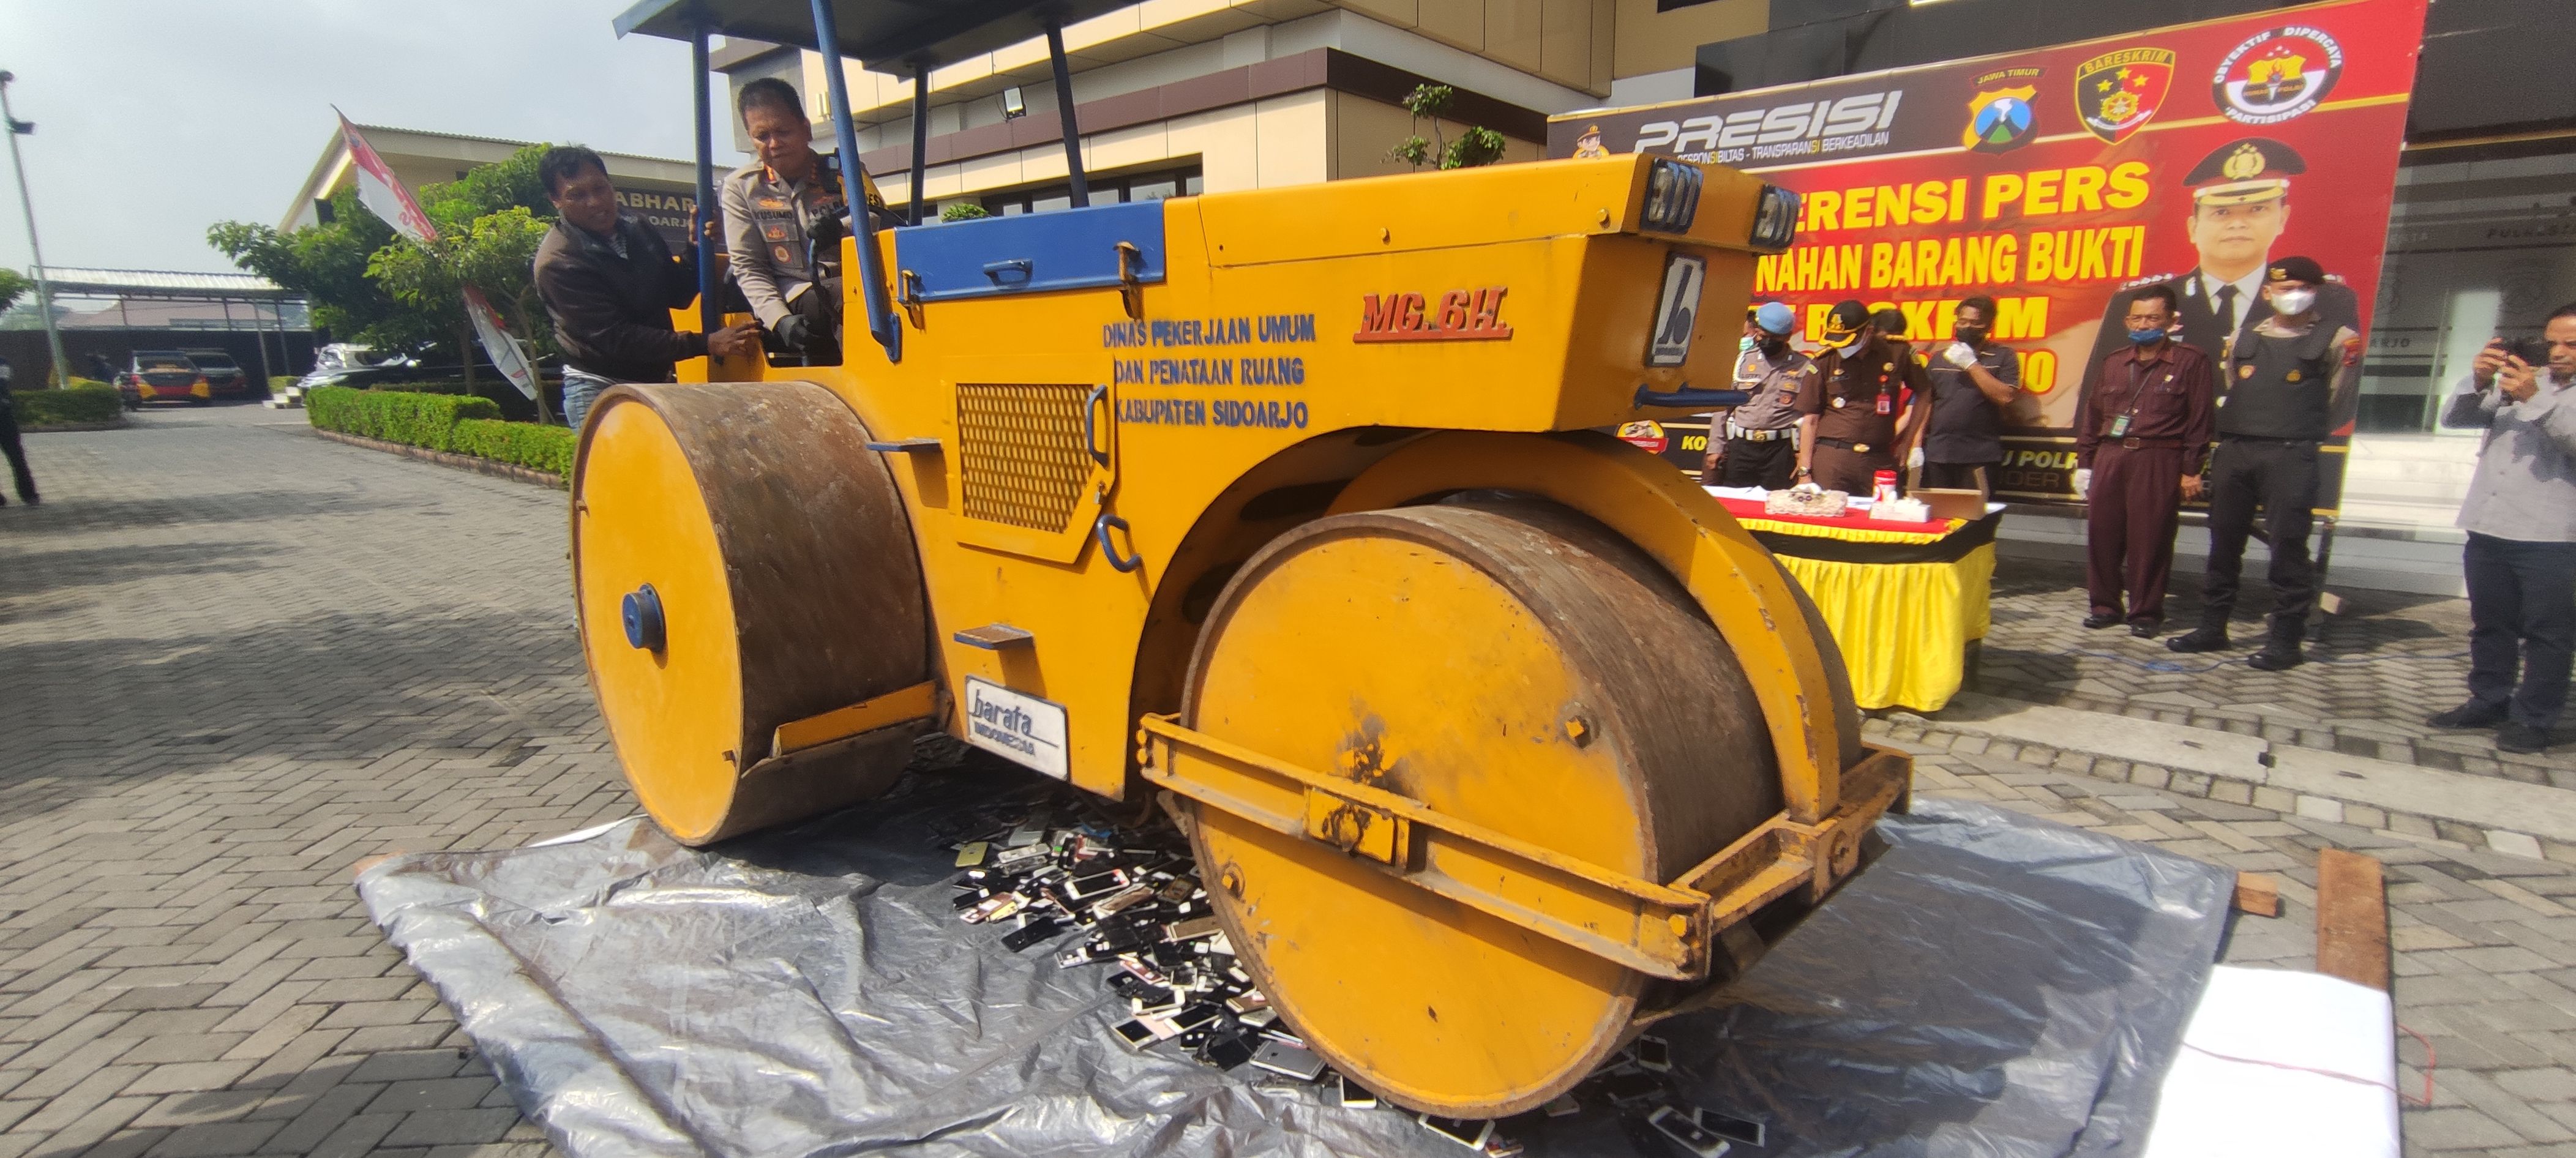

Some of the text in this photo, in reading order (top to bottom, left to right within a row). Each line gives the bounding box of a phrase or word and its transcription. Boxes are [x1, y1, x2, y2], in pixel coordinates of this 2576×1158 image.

[2084, 49, 2170, 73] BARESKRIM
[2214, 31, 2271, 84] OBYEKTIF
[2283, 26, 2342, 69] DIPERCAYA
[1977, 67, 2040, 84] JAWA TIMUR
[1633, 90, 1903, 154] PRESISI
[2225, 99, 2317, 125] PARTISIPASI
[1752, 140, 1822, 160] TRANSPARANSI
[1822, 131, 1890, 152] BERKEADILAN
[1983, 161, 2151, 219] PERS
[1870, 233, 2018, 289] BARANG
[2027, 225, 2146, 283] BUKTI
[1103, 313, 1316, 348] DINAS PEKERJAAN UMUM
[1115, 357, 1305, 386] DAN PENATAAN RUANG
[1116, 399, 1309, 428] KABUPATEN SIDOARJO
[970, 689, 1033, 736] barata
